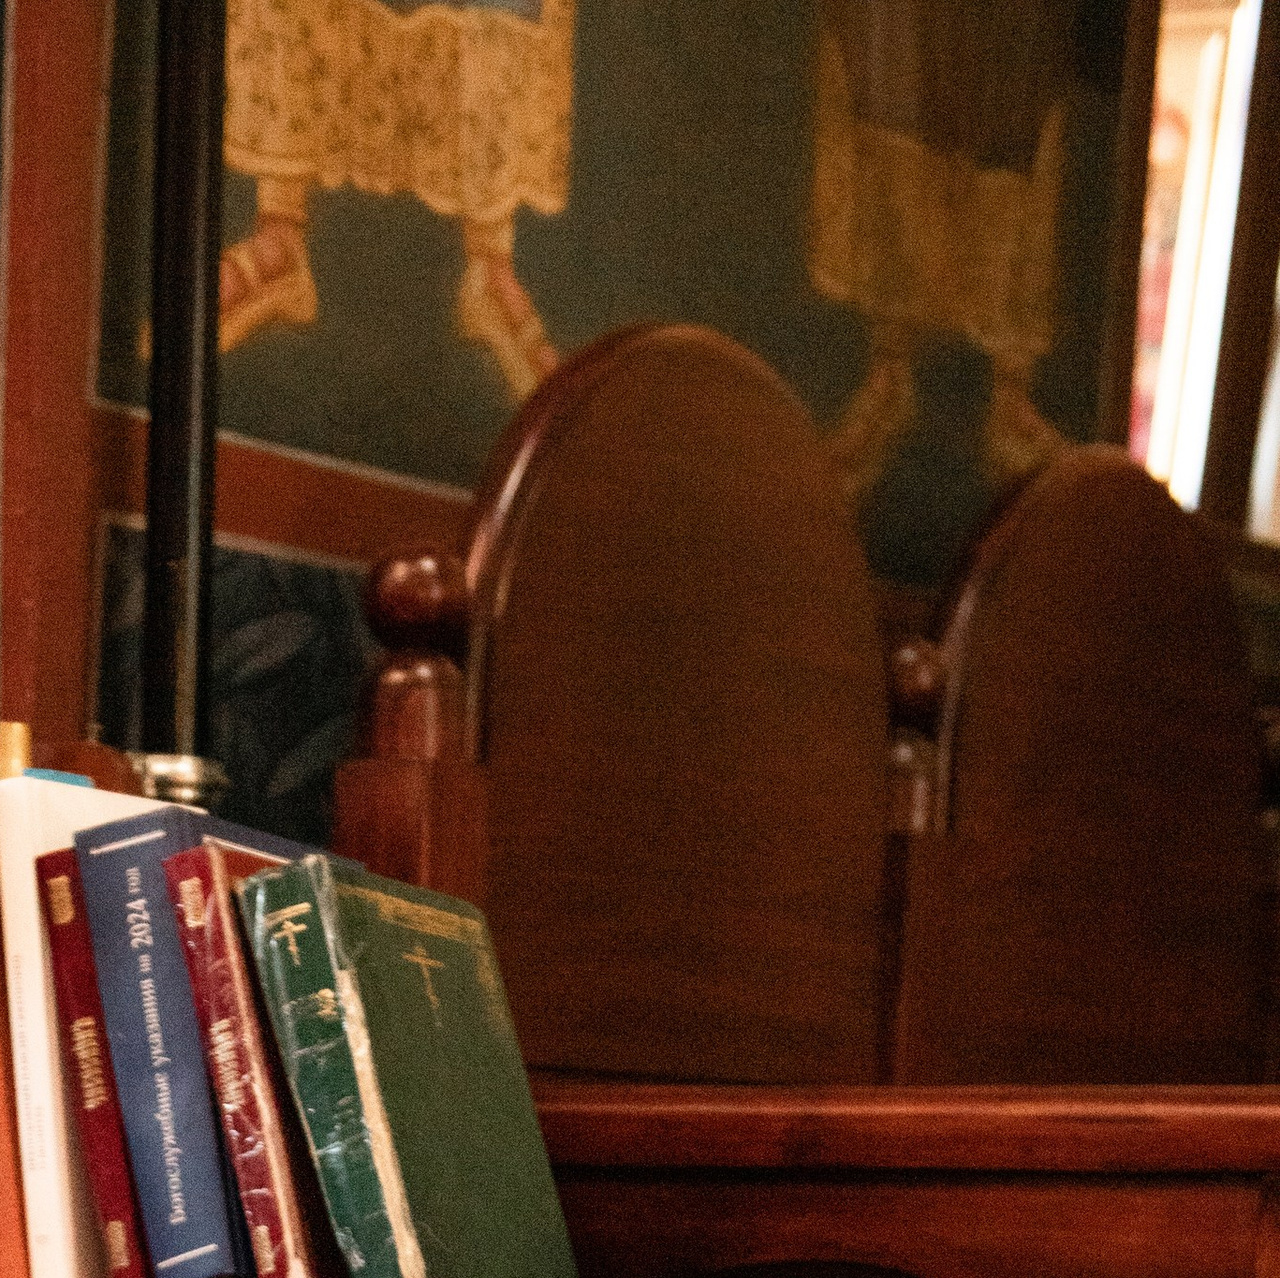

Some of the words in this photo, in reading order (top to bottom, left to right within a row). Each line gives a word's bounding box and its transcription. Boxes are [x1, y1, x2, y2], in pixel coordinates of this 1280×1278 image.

[124, 866, 142, 894] год
[124, 897, 154, 948] 2024
[138, 978, 171, 1067] указания
[154, 1072, 187, 1225] Богослужебные
